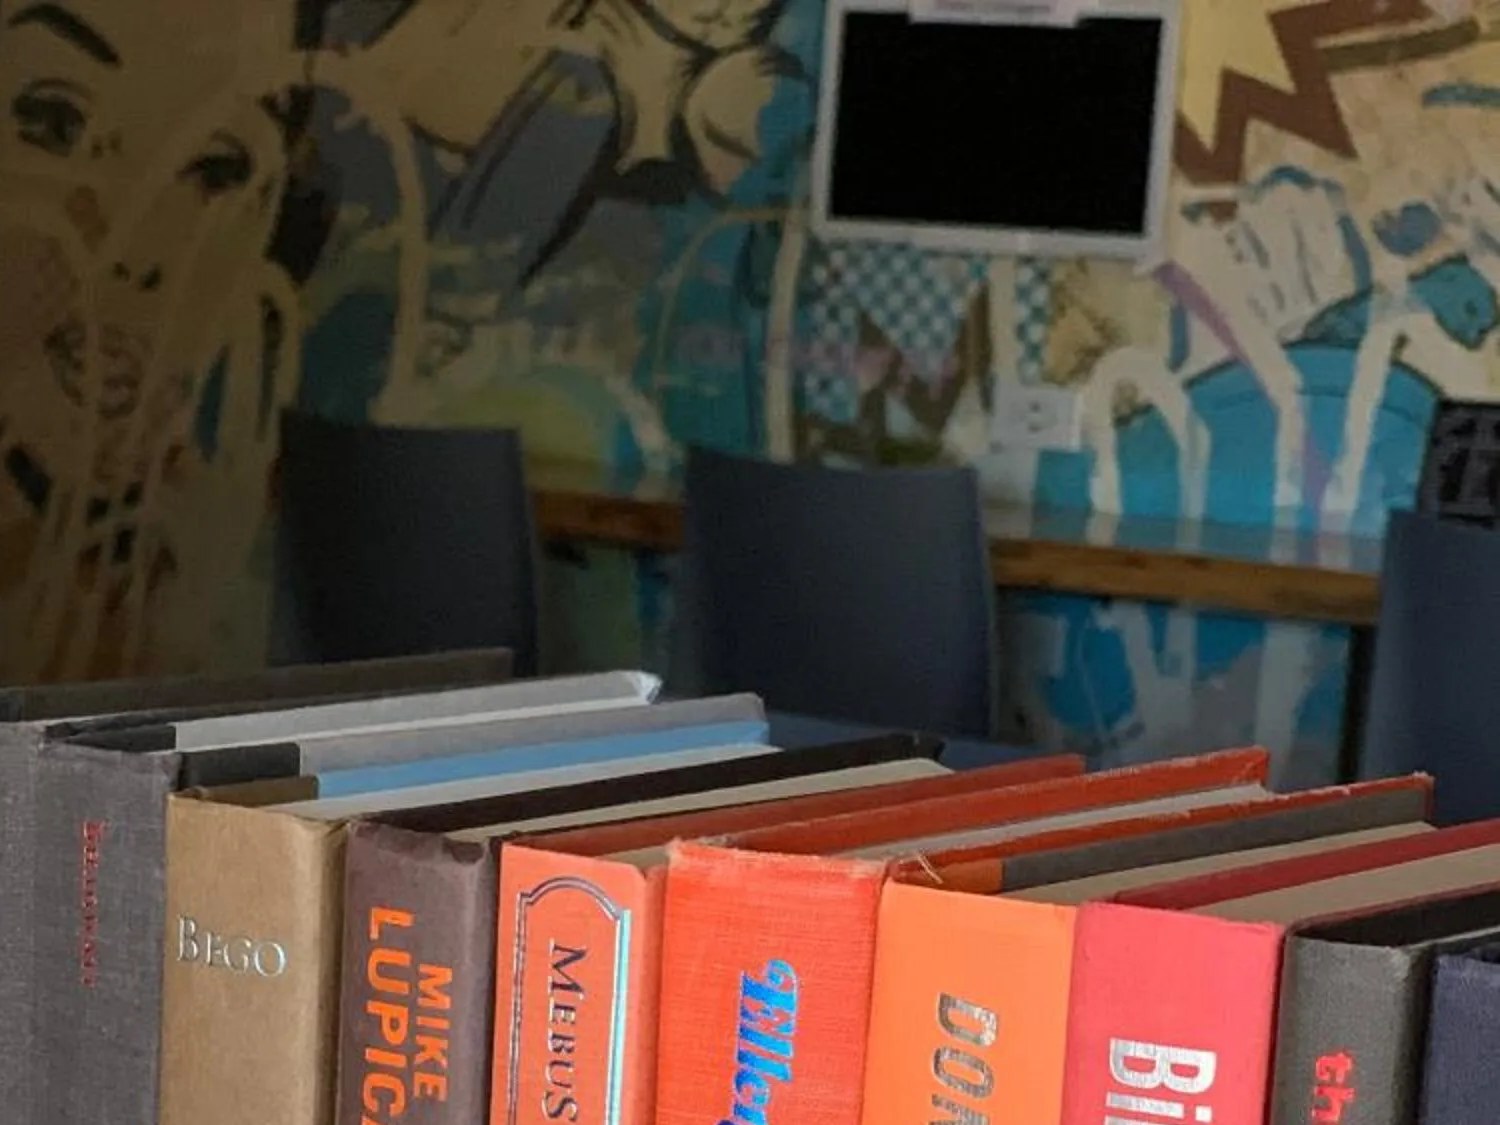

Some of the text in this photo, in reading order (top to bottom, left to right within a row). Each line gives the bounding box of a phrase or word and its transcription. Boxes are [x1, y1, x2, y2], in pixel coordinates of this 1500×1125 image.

[176, 914, 288, 978] BEGO
[414, 963, 453, 1102] MIKE
[541, 938, 588, 1123] MEBUS
